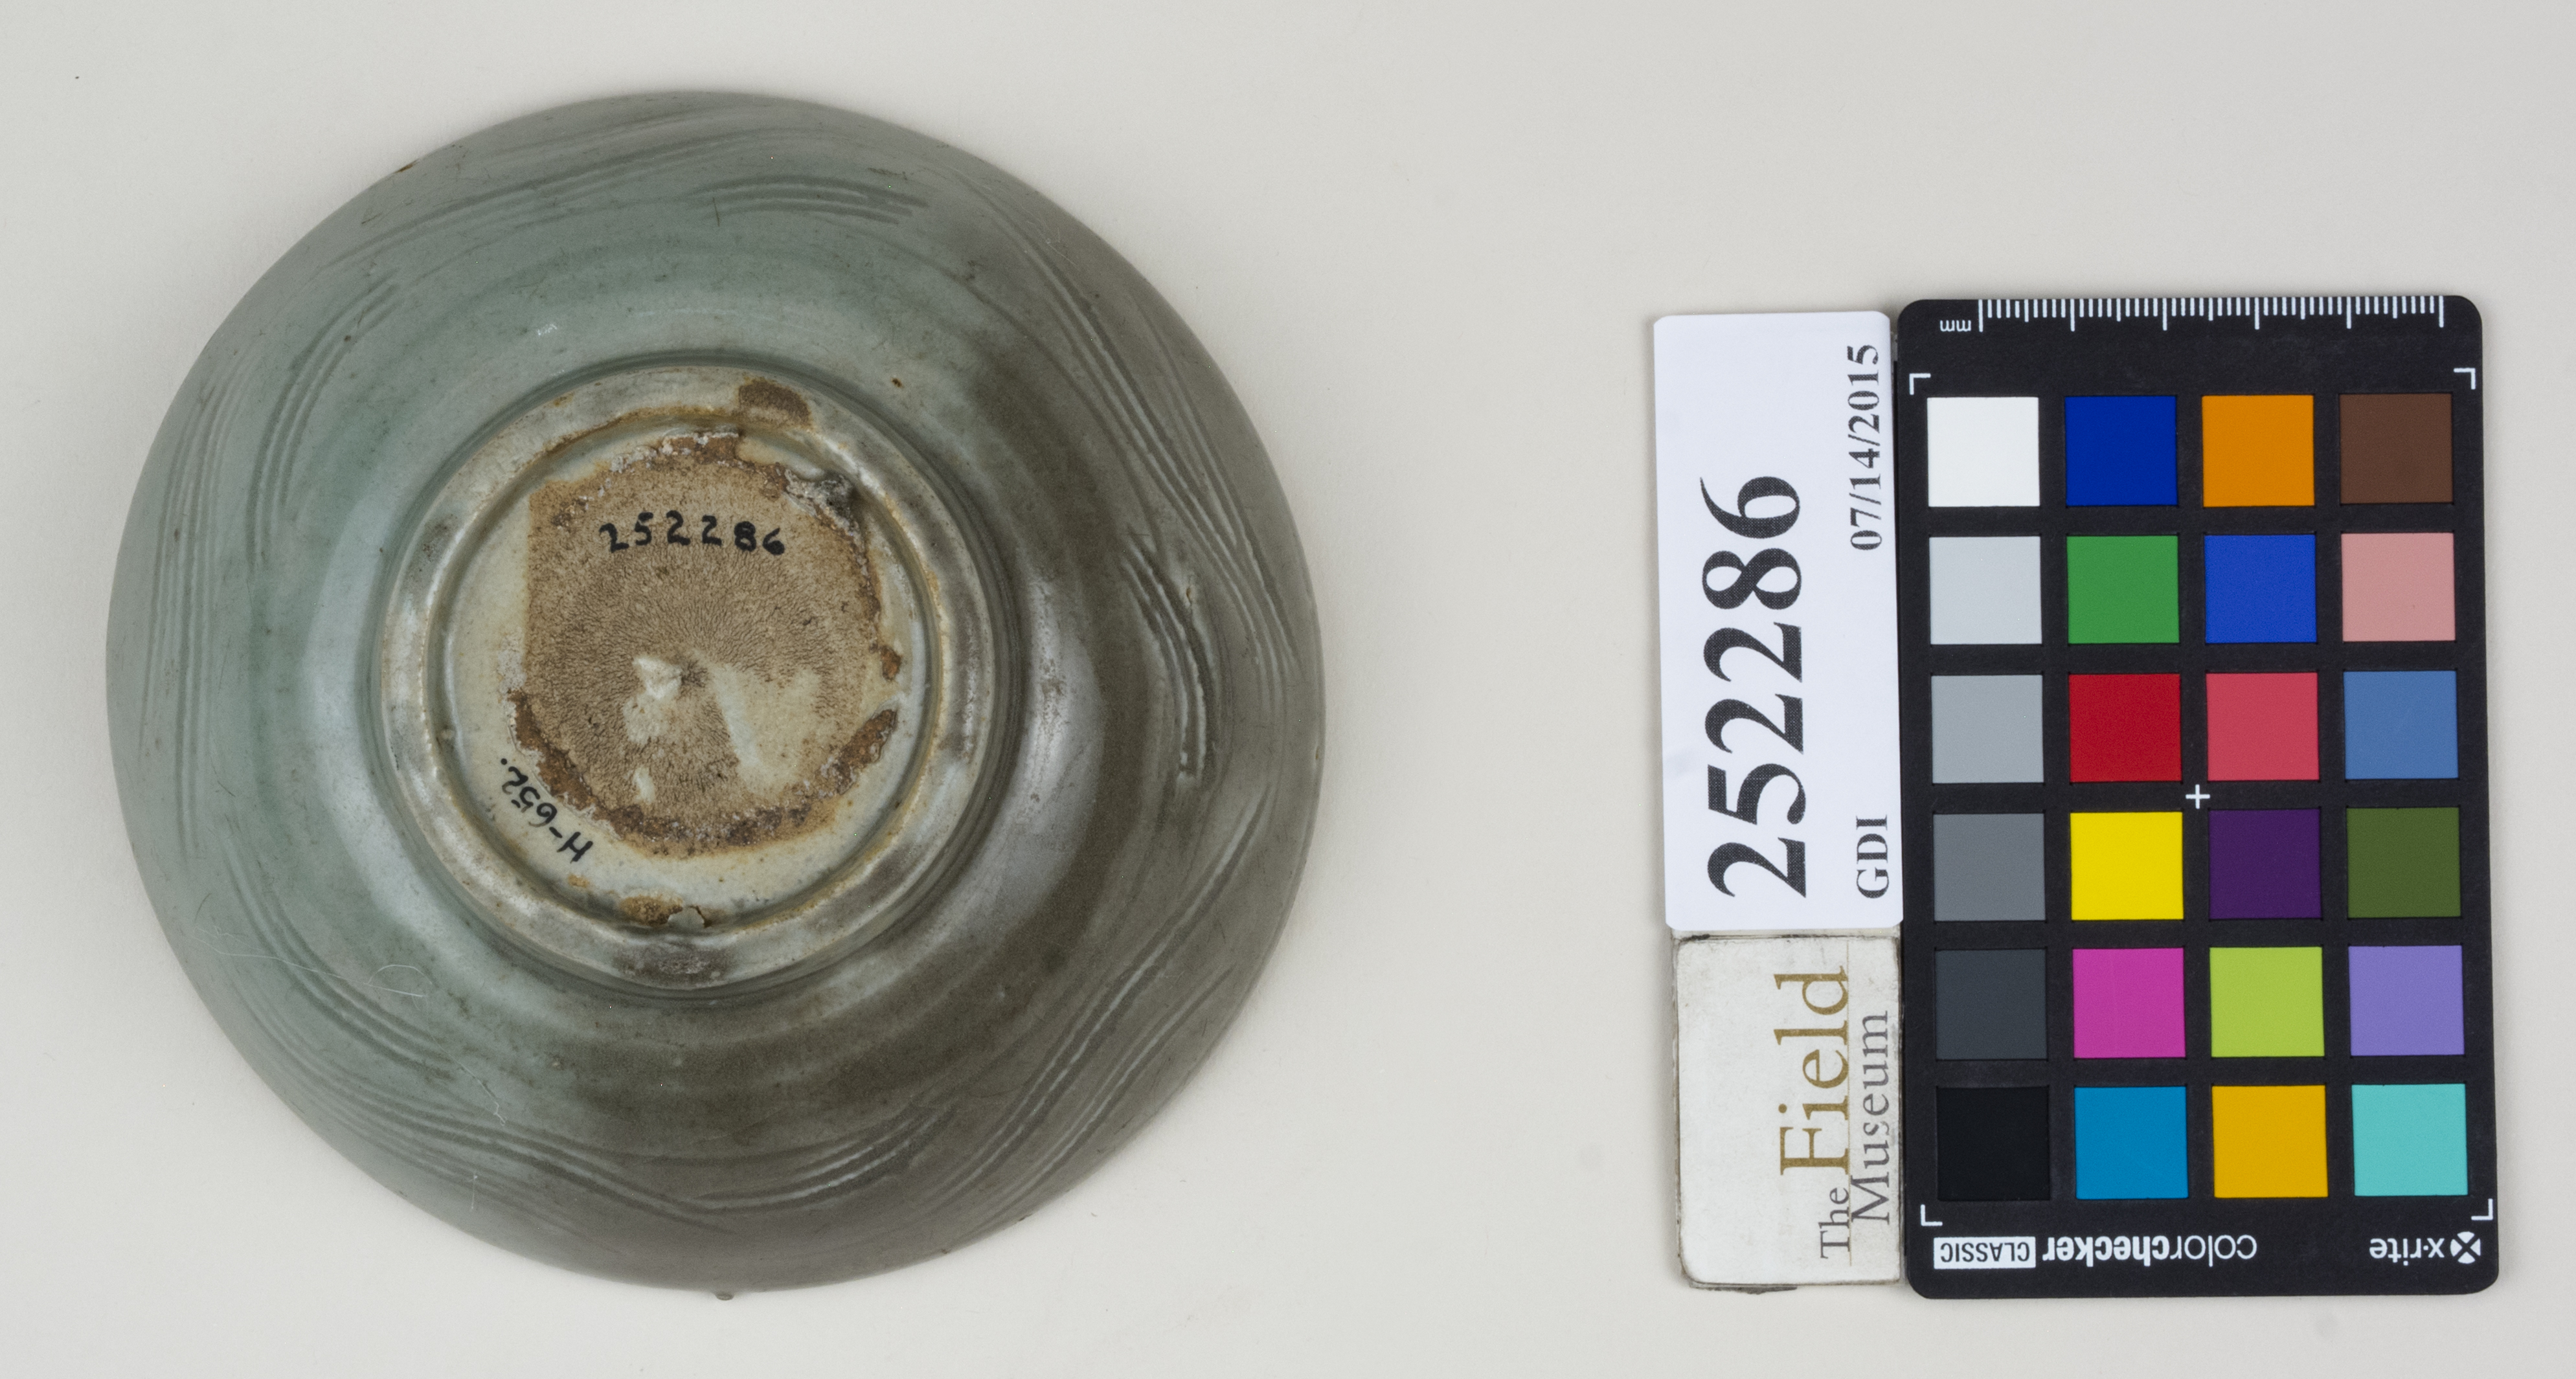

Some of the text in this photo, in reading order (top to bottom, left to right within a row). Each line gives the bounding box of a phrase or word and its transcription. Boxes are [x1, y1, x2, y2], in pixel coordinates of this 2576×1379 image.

[1940, 320, 1971, 332] mm
[1847, 344, 1882, 550] 07/14/2015
[599, 510, 785, 555] 252286
[1699, 475, 1806, 899] 252286
[1856, 814, 1888, 899] GDI
[1773, 965, 1850, 1259] The Field
[1851, 1010, 1890, 1225] Museum
[1941, 1241, 2031, 1263] CLASSIC
